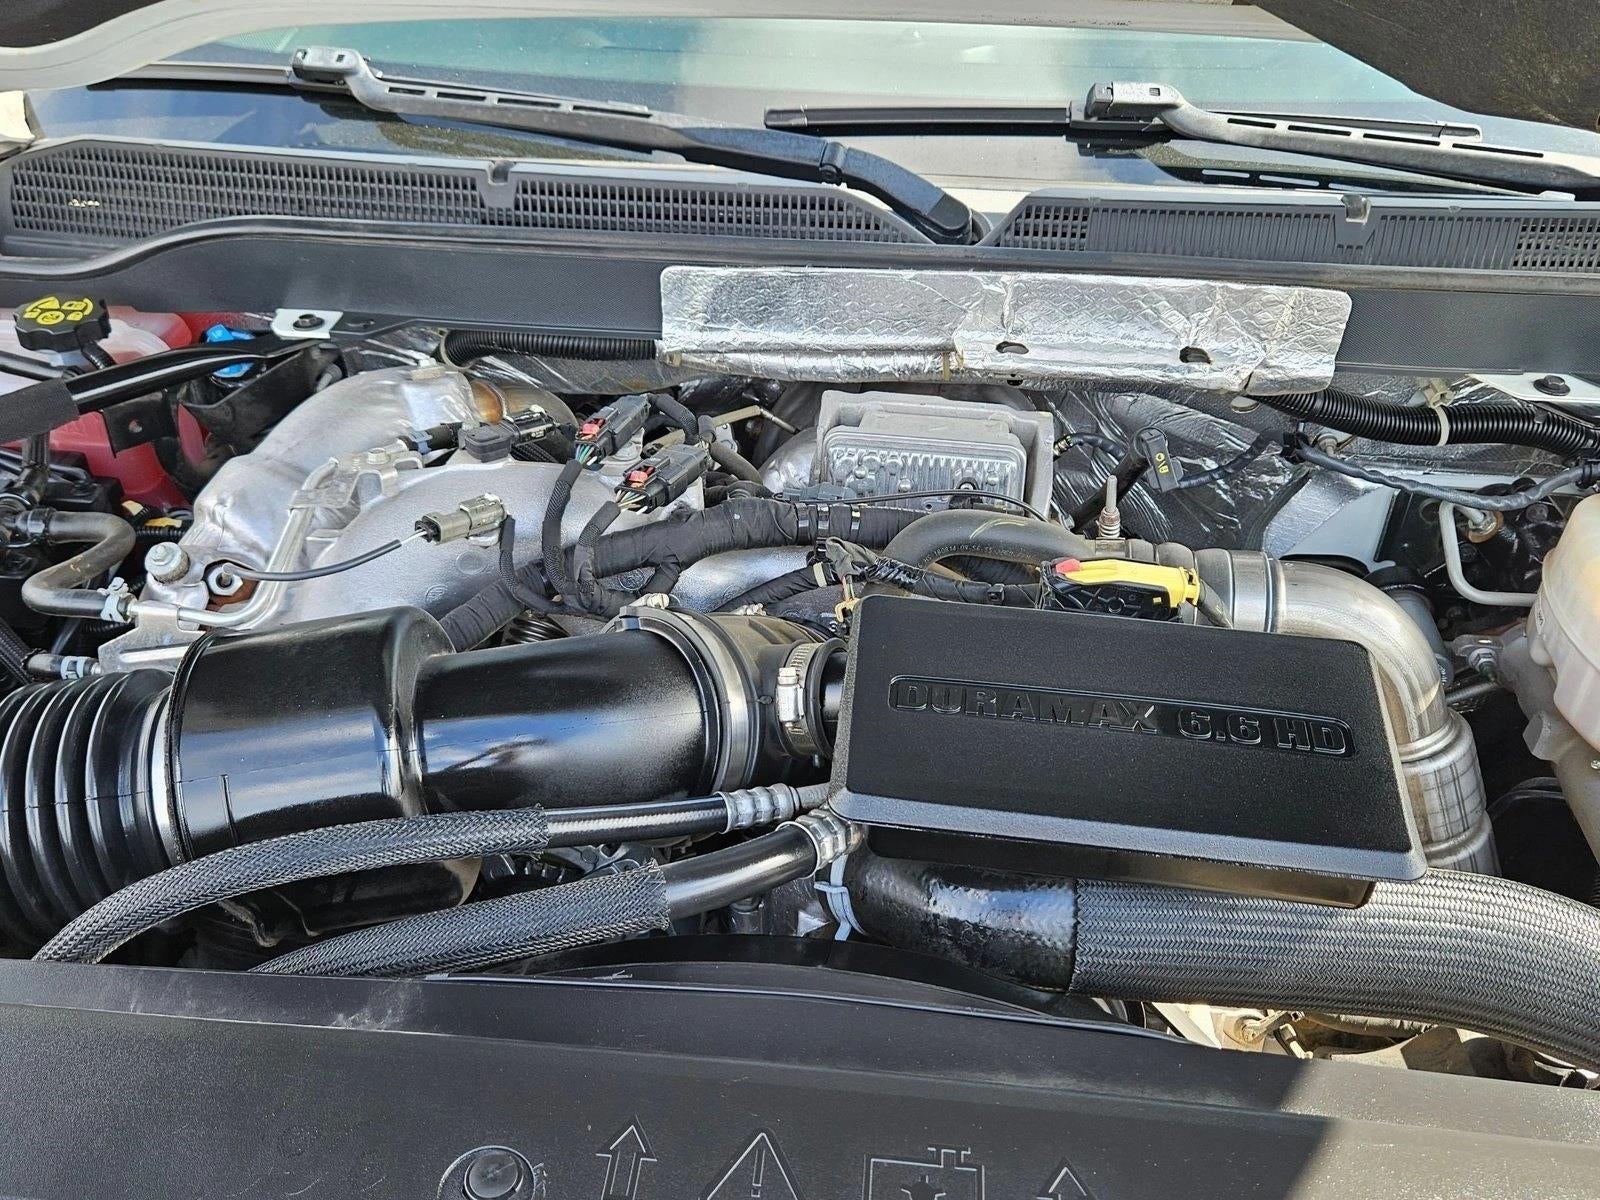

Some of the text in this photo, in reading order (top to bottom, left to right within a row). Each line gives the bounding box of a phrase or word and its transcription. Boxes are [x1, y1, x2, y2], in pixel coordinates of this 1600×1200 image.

[896, 683, 1347, 755] DURAMAX 6.6 HD
